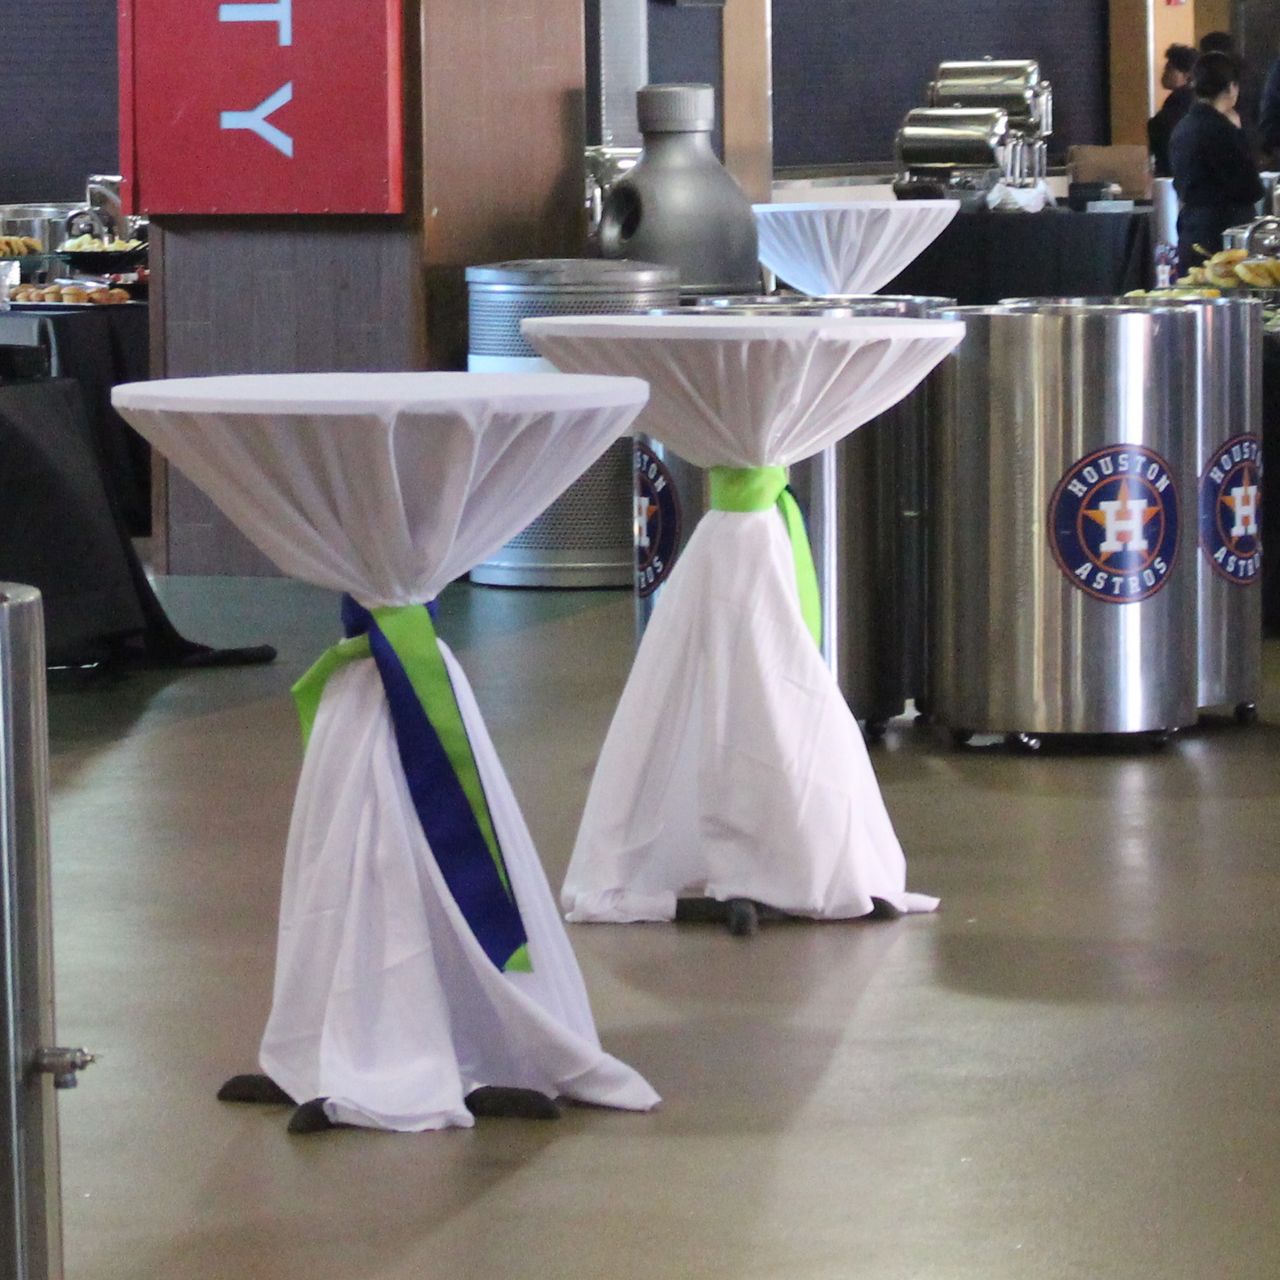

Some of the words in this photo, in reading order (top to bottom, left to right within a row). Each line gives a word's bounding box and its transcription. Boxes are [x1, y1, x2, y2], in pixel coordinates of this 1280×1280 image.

[1067, 452, 1170, 499] HOUSTON
[1098, 498, 1150, 553] H
[1230, 485, 1258, 538] H
[1074, 556, 1167, 596] ASTROS
[1213, 545, 1262, 578] ASTRO
